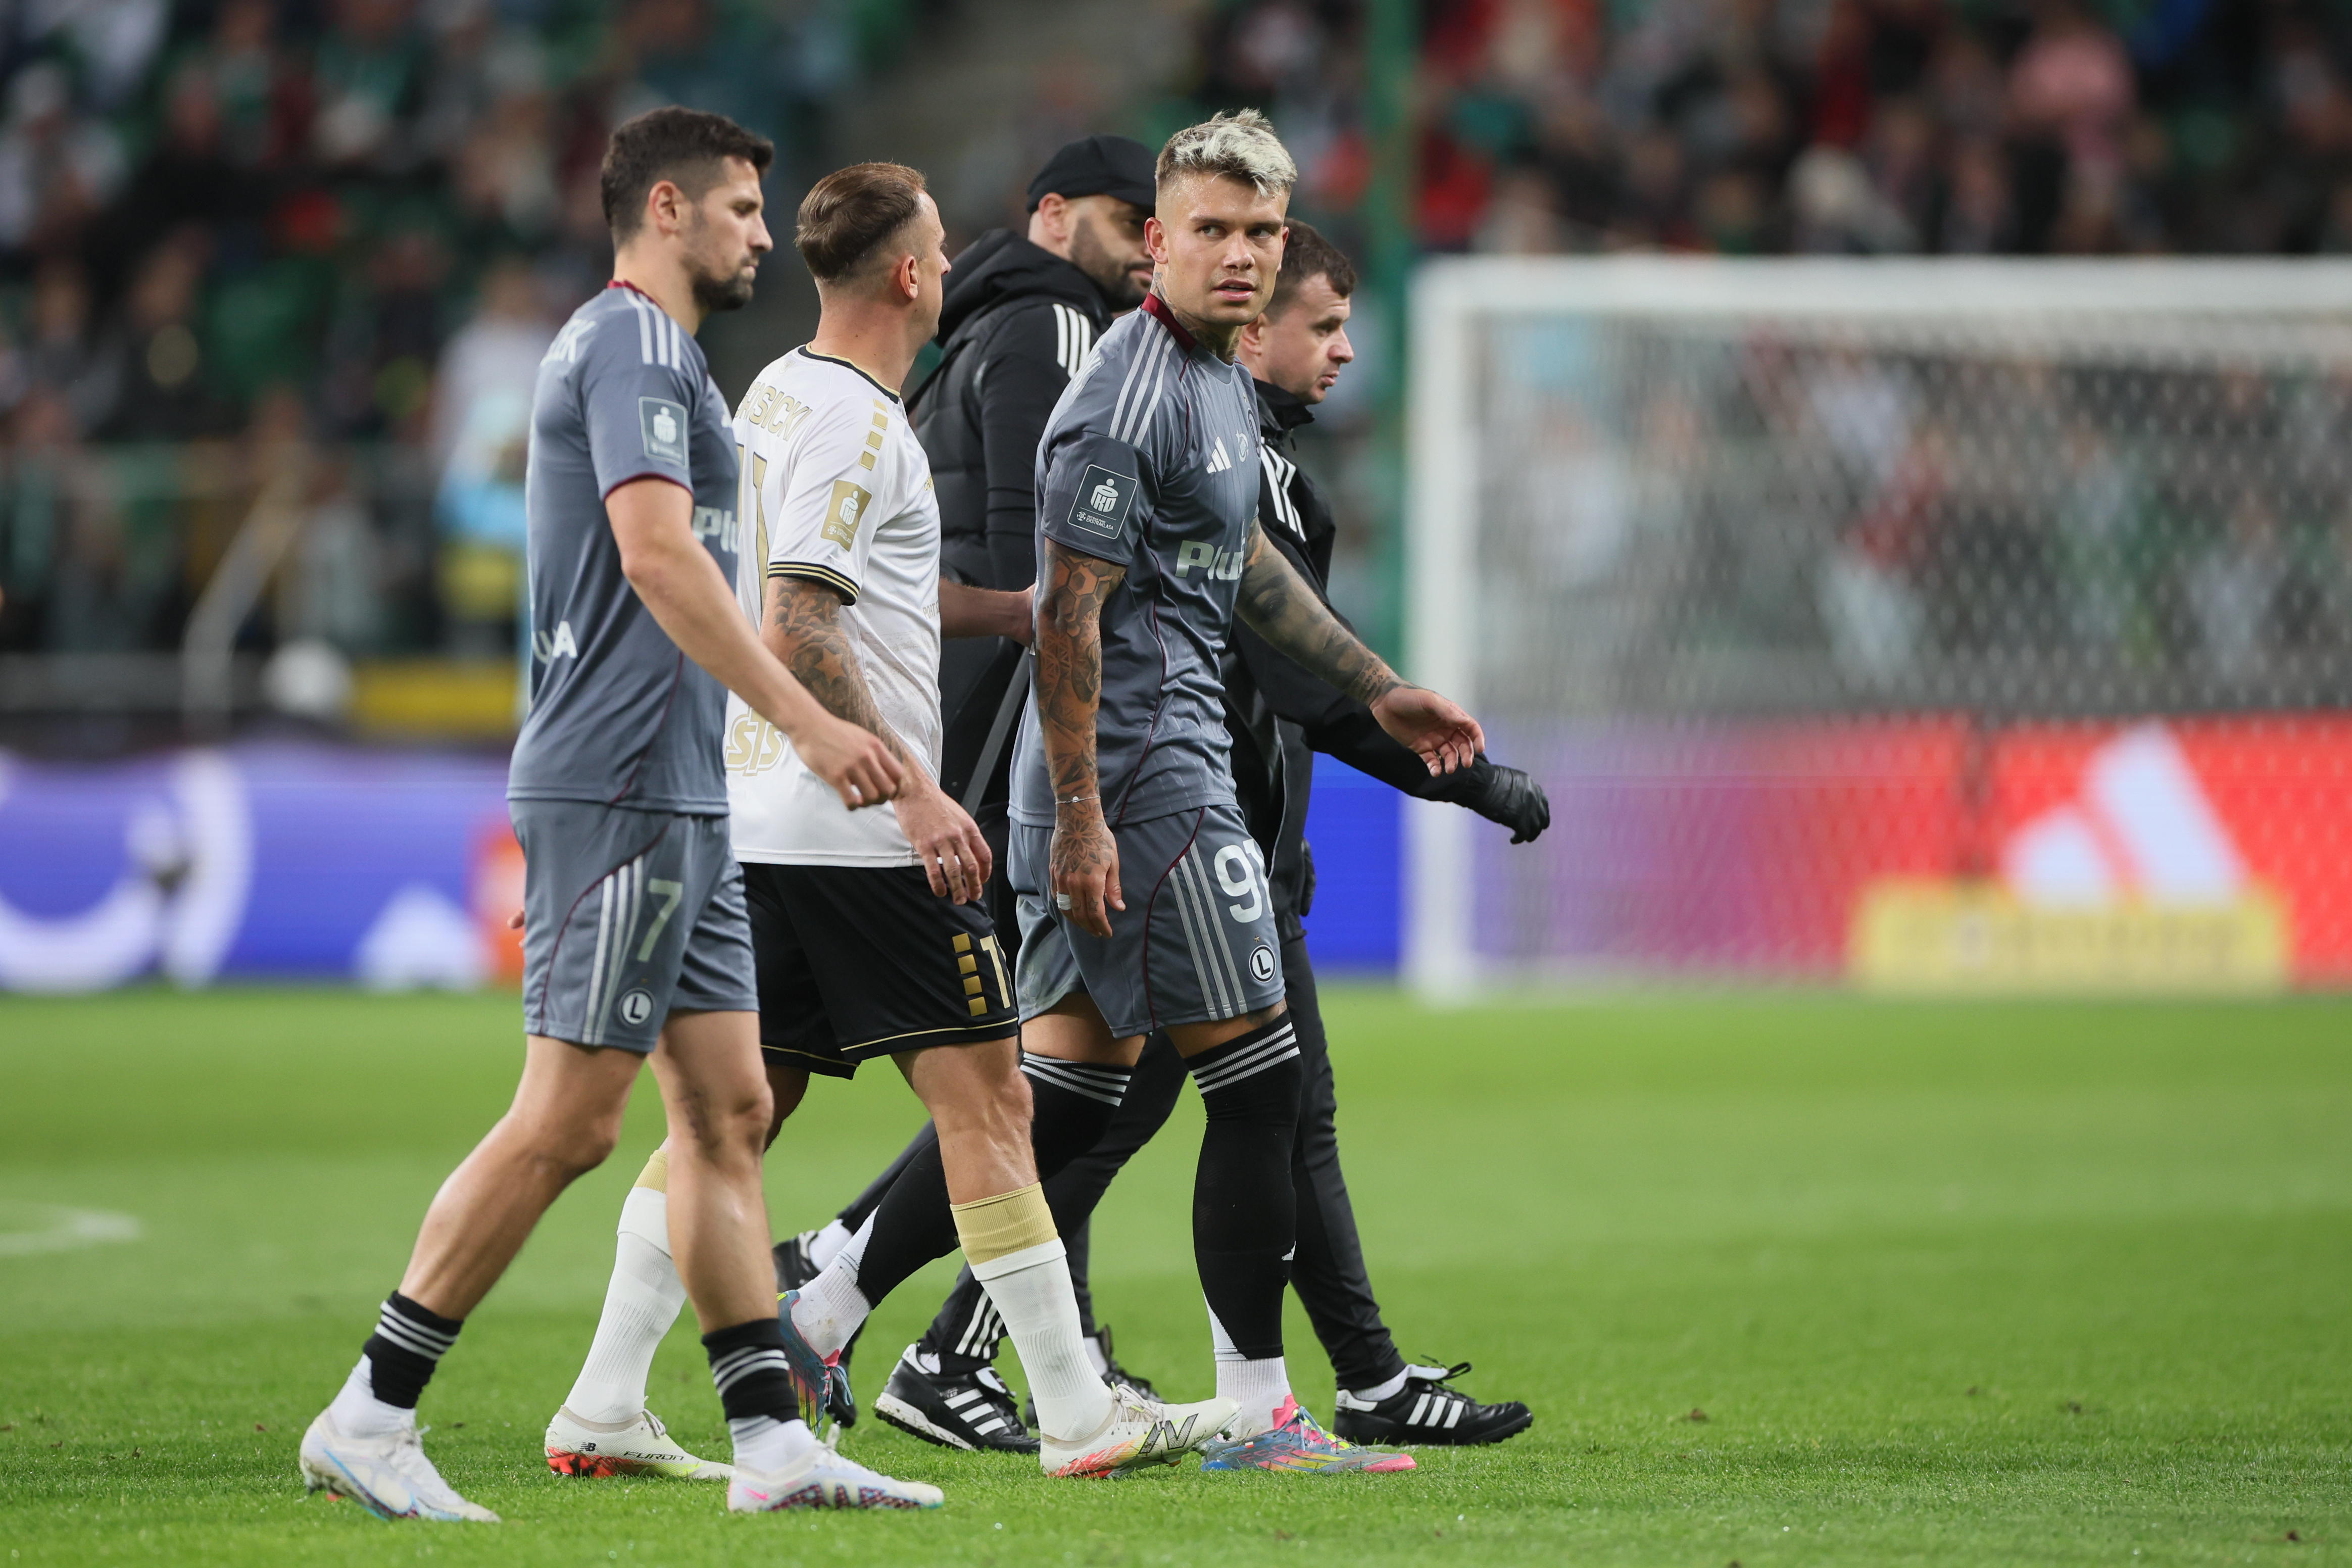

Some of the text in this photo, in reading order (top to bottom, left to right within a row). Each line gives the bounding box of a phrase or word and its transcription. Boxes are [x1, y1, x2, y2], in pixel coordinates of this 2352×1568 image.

[1086, 517, 1114, 530] EKSTRAKLASA
[637, 877, 683, 962] 7
[623, 1451, 684, 1461] FURON
